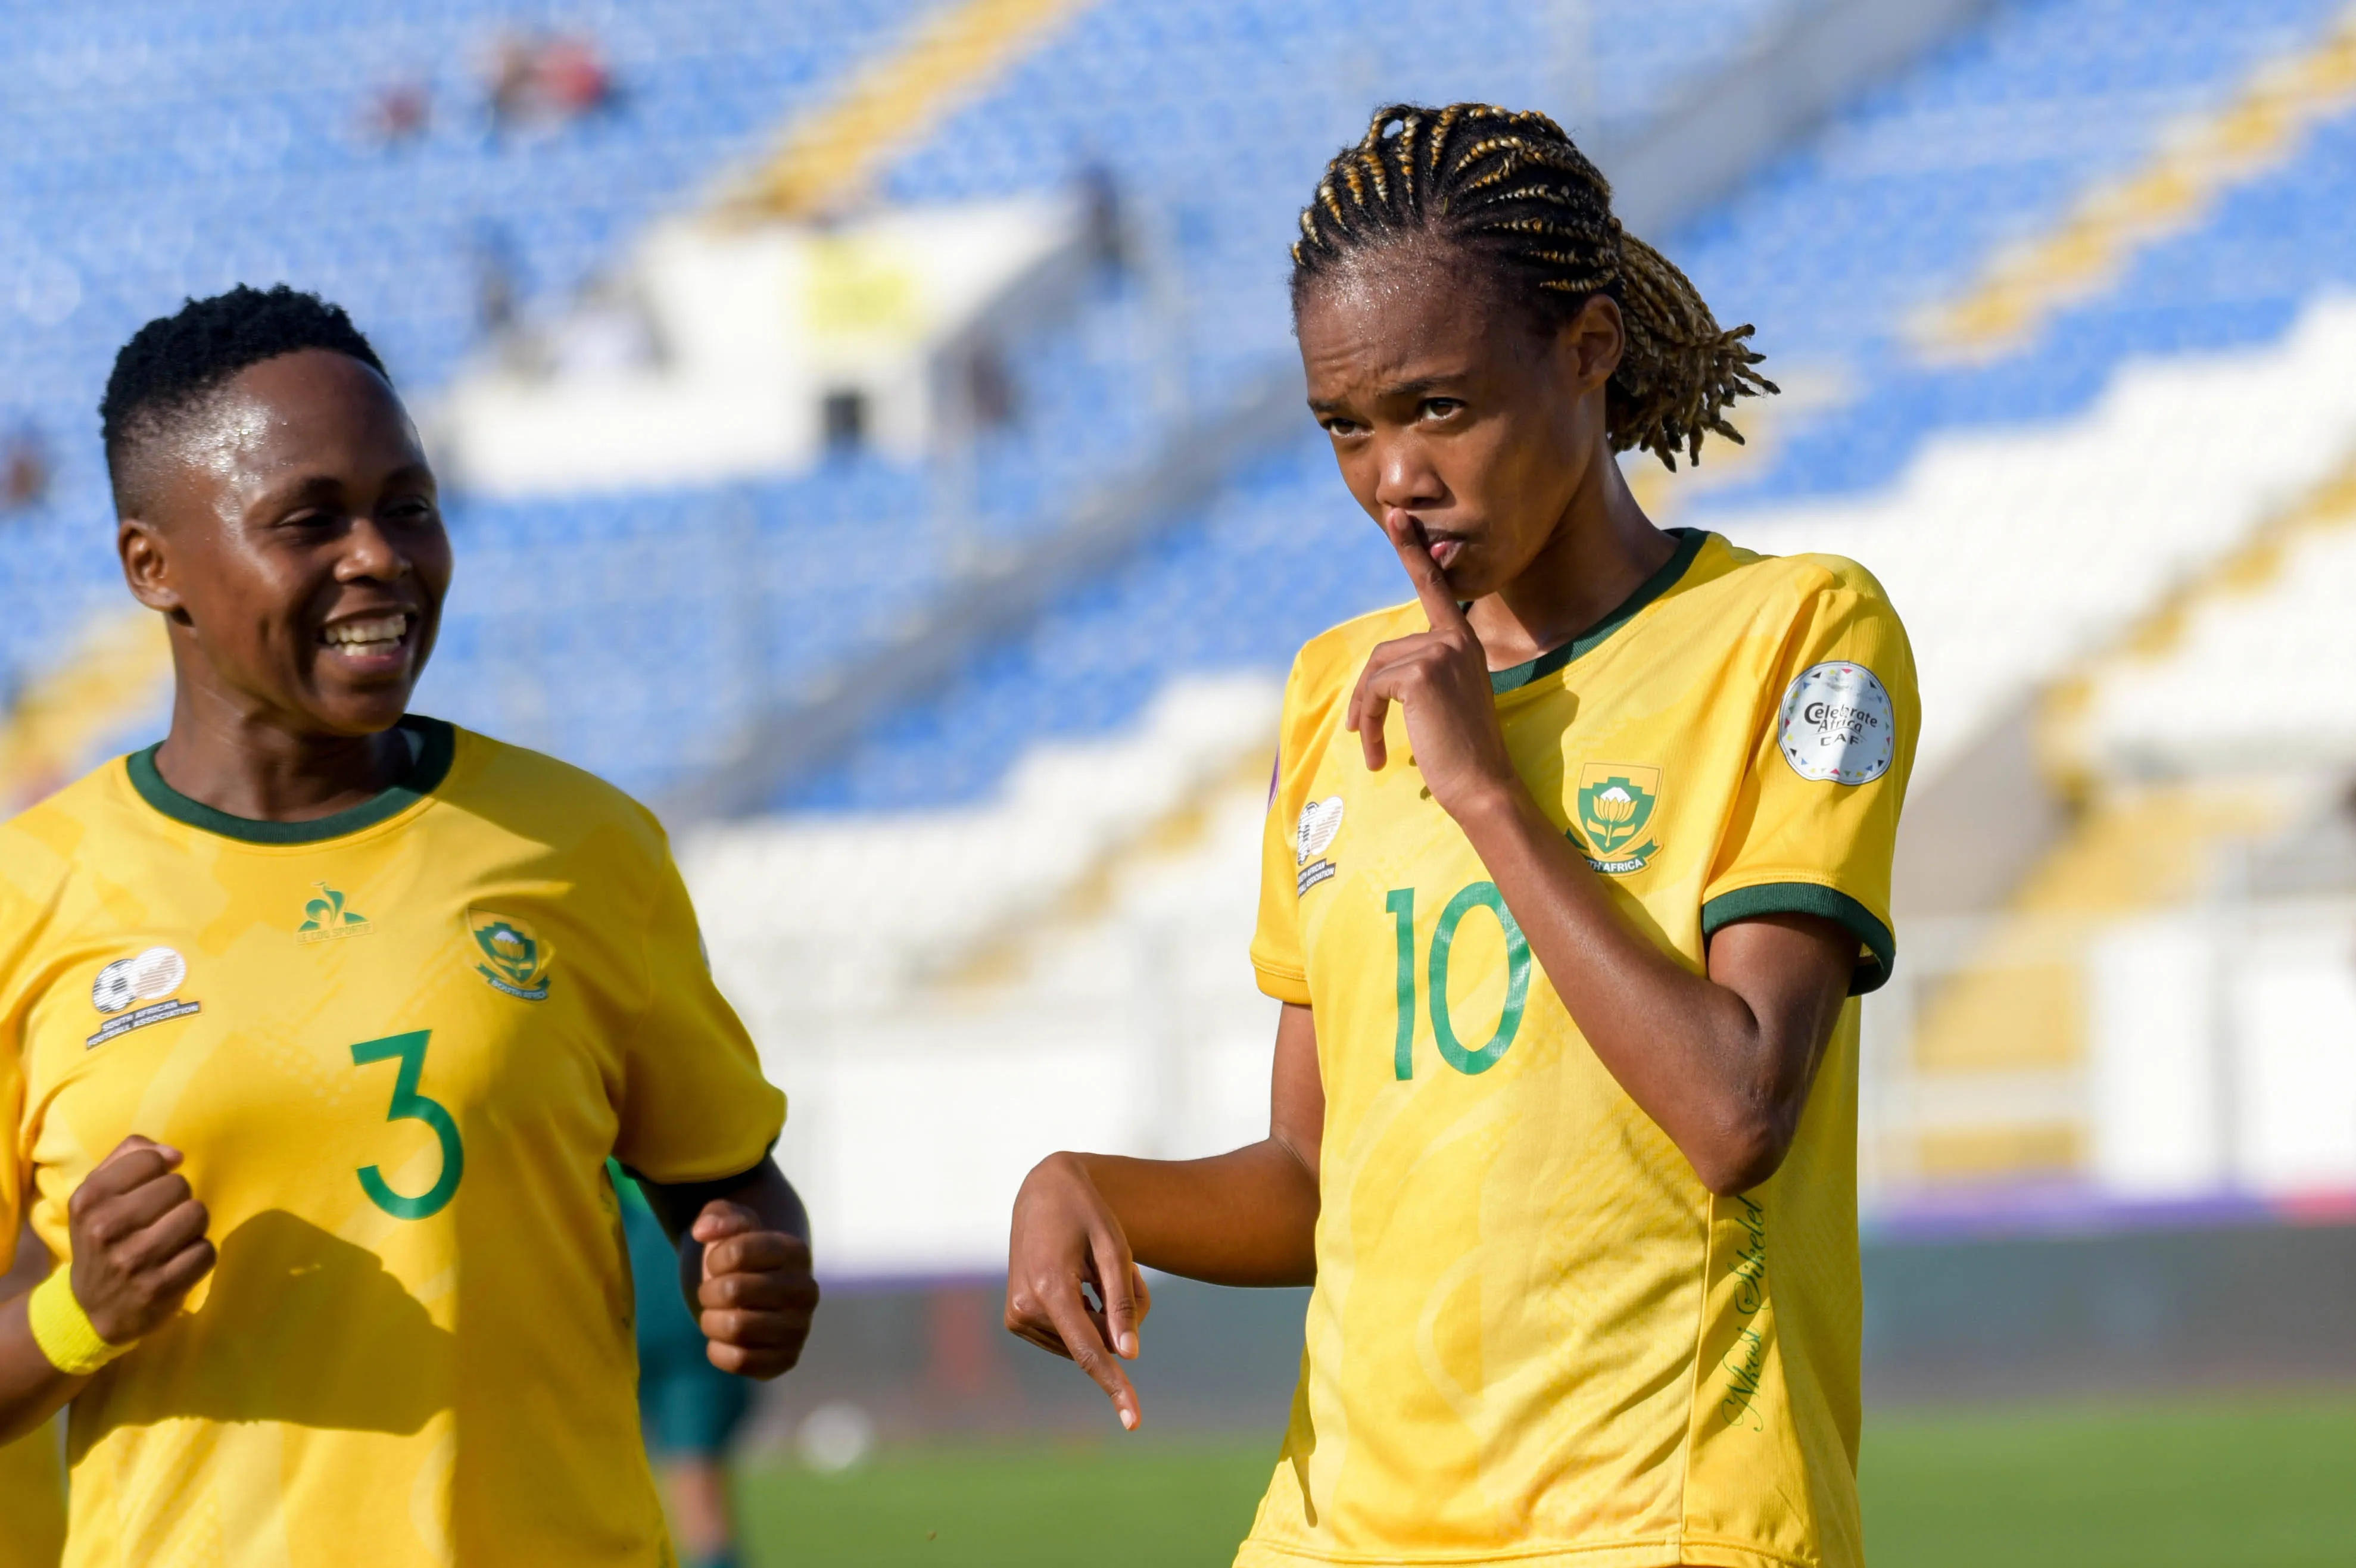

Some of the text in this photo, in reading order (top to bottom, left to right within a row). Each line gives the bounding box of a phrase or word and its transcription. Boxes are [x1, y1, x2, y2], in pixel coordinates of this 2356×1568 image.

[1804, 702, 1878, 728] Celebrate
[1817, 718, 1863, 734] Africa
[1820, 733, 1859, 747] CAF
[1603, 858, 1644, 872] AFRICA
[1385, 881, 1532, 1081] 10
[349, 1028, 465, 1221] 3
[1721, 1324, 1763, 1432] Nkosi
